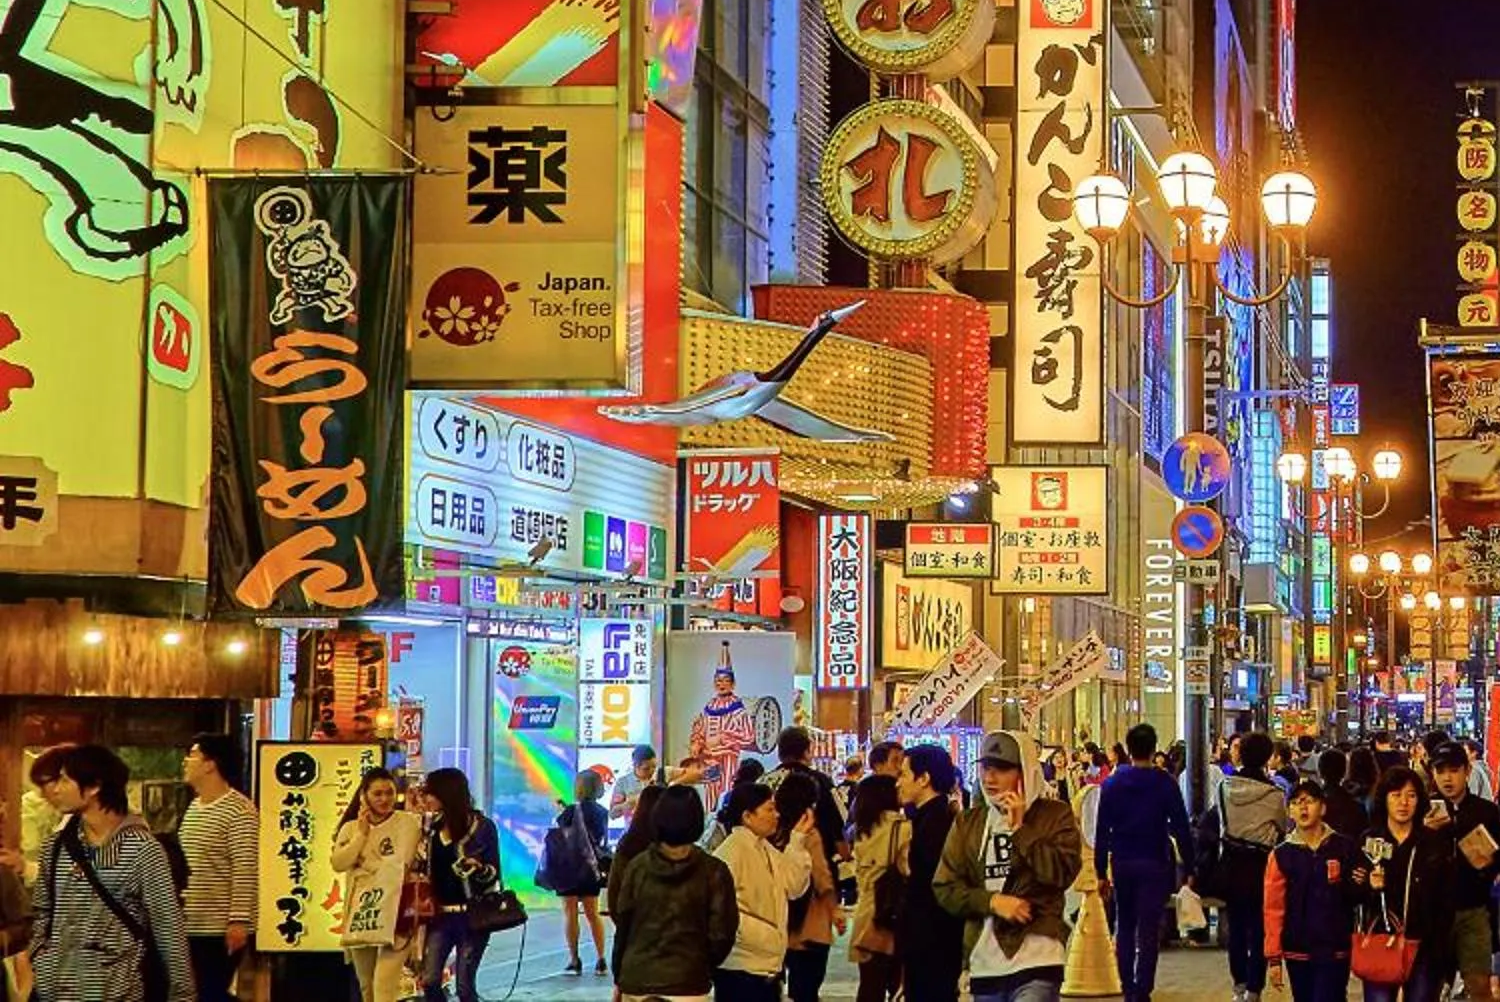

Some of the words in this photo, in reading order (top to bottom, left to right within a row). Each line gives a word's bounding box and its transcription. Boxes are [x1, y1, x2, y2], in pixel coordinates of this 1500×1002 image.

[467, 125, 567, 224] 薬
[538, 272, 612, 293] Japan.
[530, 298, 612, 317] Tax-free
[559, 321, 612, 342] Shop
[434, 408, 489, 459] くすり
[518, 432, 566, 481] 化粧品
[236, 330, 377, 610] らーめん
[692, 460, 775, 488] ツルハ
[430, 487, 486, 536] 日用品
[693, 492, 760, 513] ドラッグ
[829, 525, 860, 678] 大阪紀念品
[1145, 538, 1173, 662] FOREVER
[513, 702, 557, 717] UnionPay
